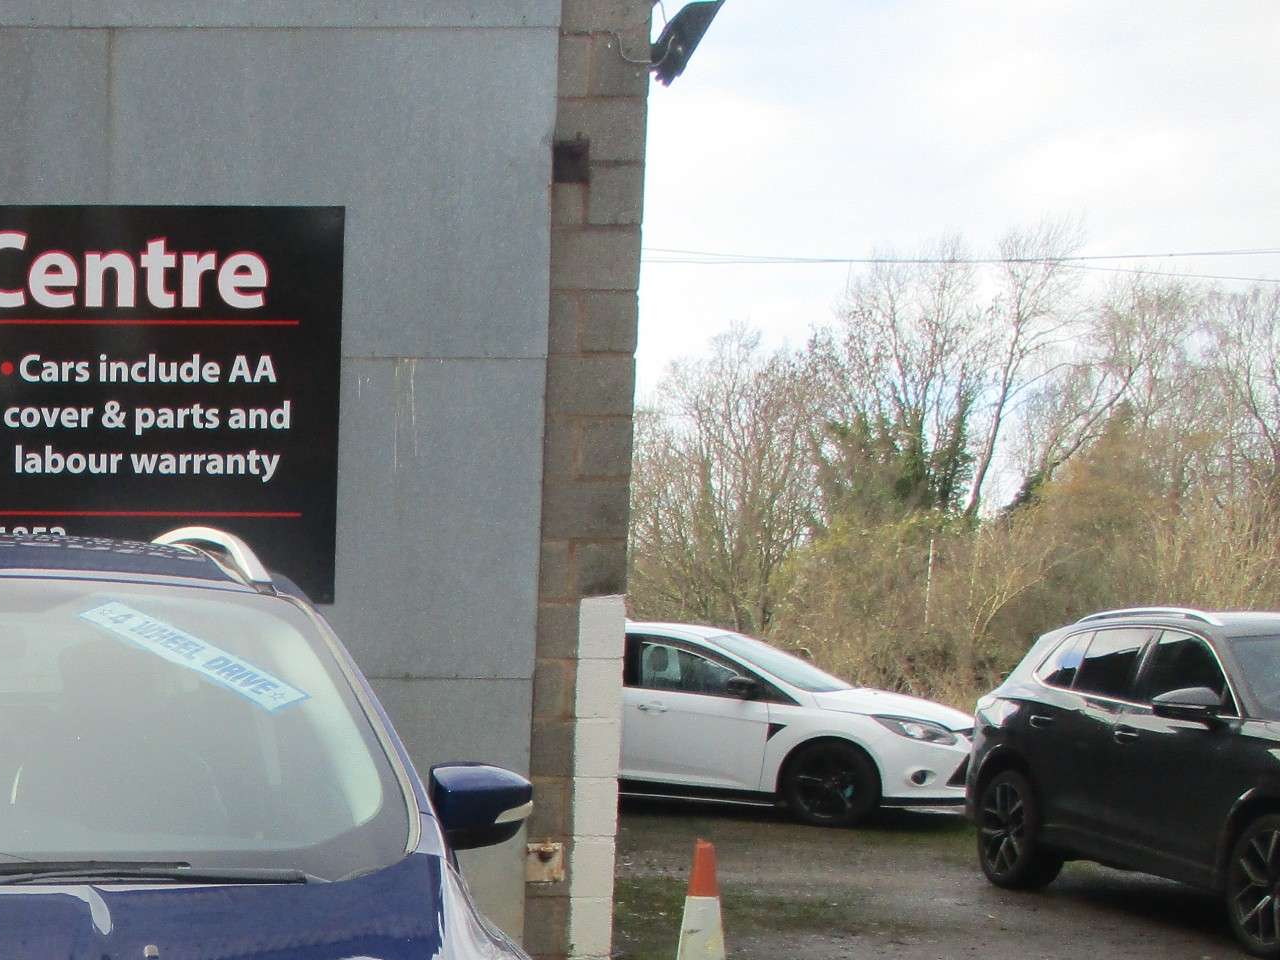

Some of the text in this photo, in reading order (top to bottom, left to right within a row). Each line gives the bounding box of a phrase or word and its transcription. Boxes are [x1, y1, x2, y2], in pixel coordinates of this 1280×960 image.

[19, 353, 277, 383] Cars include AA
[3, 400, 291, 436] cover & parts and
[15, 444, 281, 483] labour warranty
[128, 619, 205, 661] WHEEL
[201, 655, 279, 695] DRIVE
